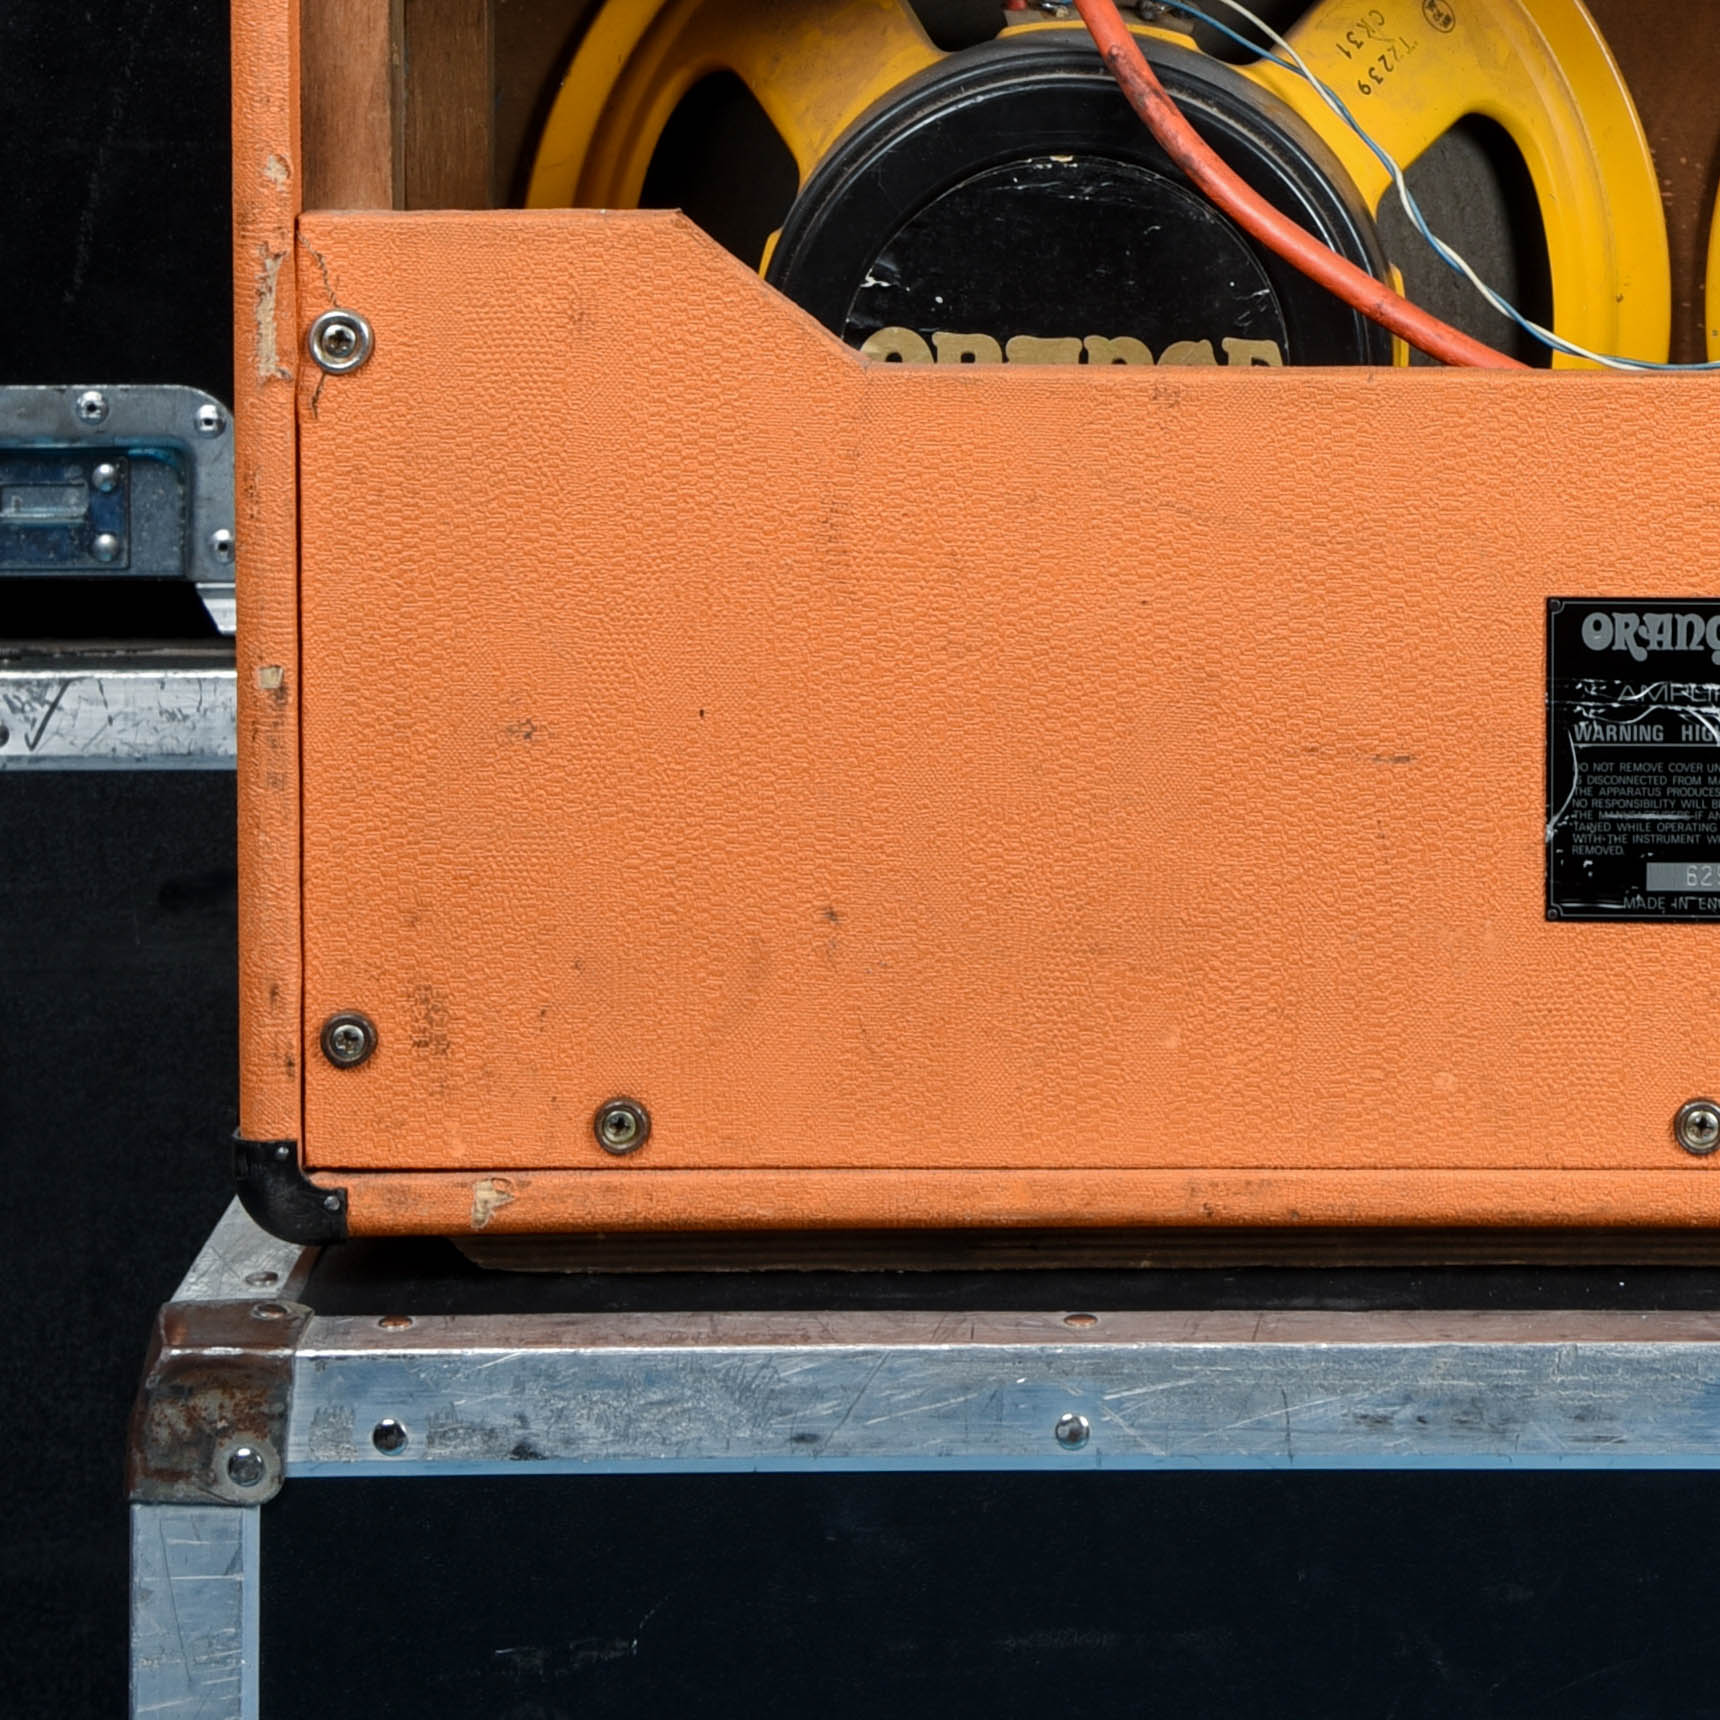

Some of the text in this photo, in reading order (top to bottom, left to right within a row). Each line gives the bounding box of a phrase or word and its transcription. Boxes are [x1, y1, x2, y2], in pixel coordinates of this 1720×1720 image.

[1574, 725, 1664, 742] WARNING
[1593, 762, 1614, 773] NOT
[1620, 762, 1664, 773] REMOVE
[1668, 762, 1703, 773] COVER
[1587, 775, 1667, 785] DISCONNECTED
[1673, 775, 1702, 785] FROM
[1600, 787, 1661, 798] APPARATUS
[1667, 787, 1720, 798] PRODUCES
[1572, 799, 1588, 809] NO
[1591, 799, 1676, 809] RESPONSIBILITY
[1681, 799, 1707, 809] WILL
[1574, 810, 1593, 821] THE
[1616, 822, 1651, 832] WHILE
[1657, 822, 1717, 832] OPERATING
[1572, 834, 1601, 844] WITH
[1607, 834, 1628, 844] THE
[1632, 834, 1701, 844] INSTRUMENT
[1623, 897, 1665, 910] MADE
[1674, 897, 1688, 910] IN
